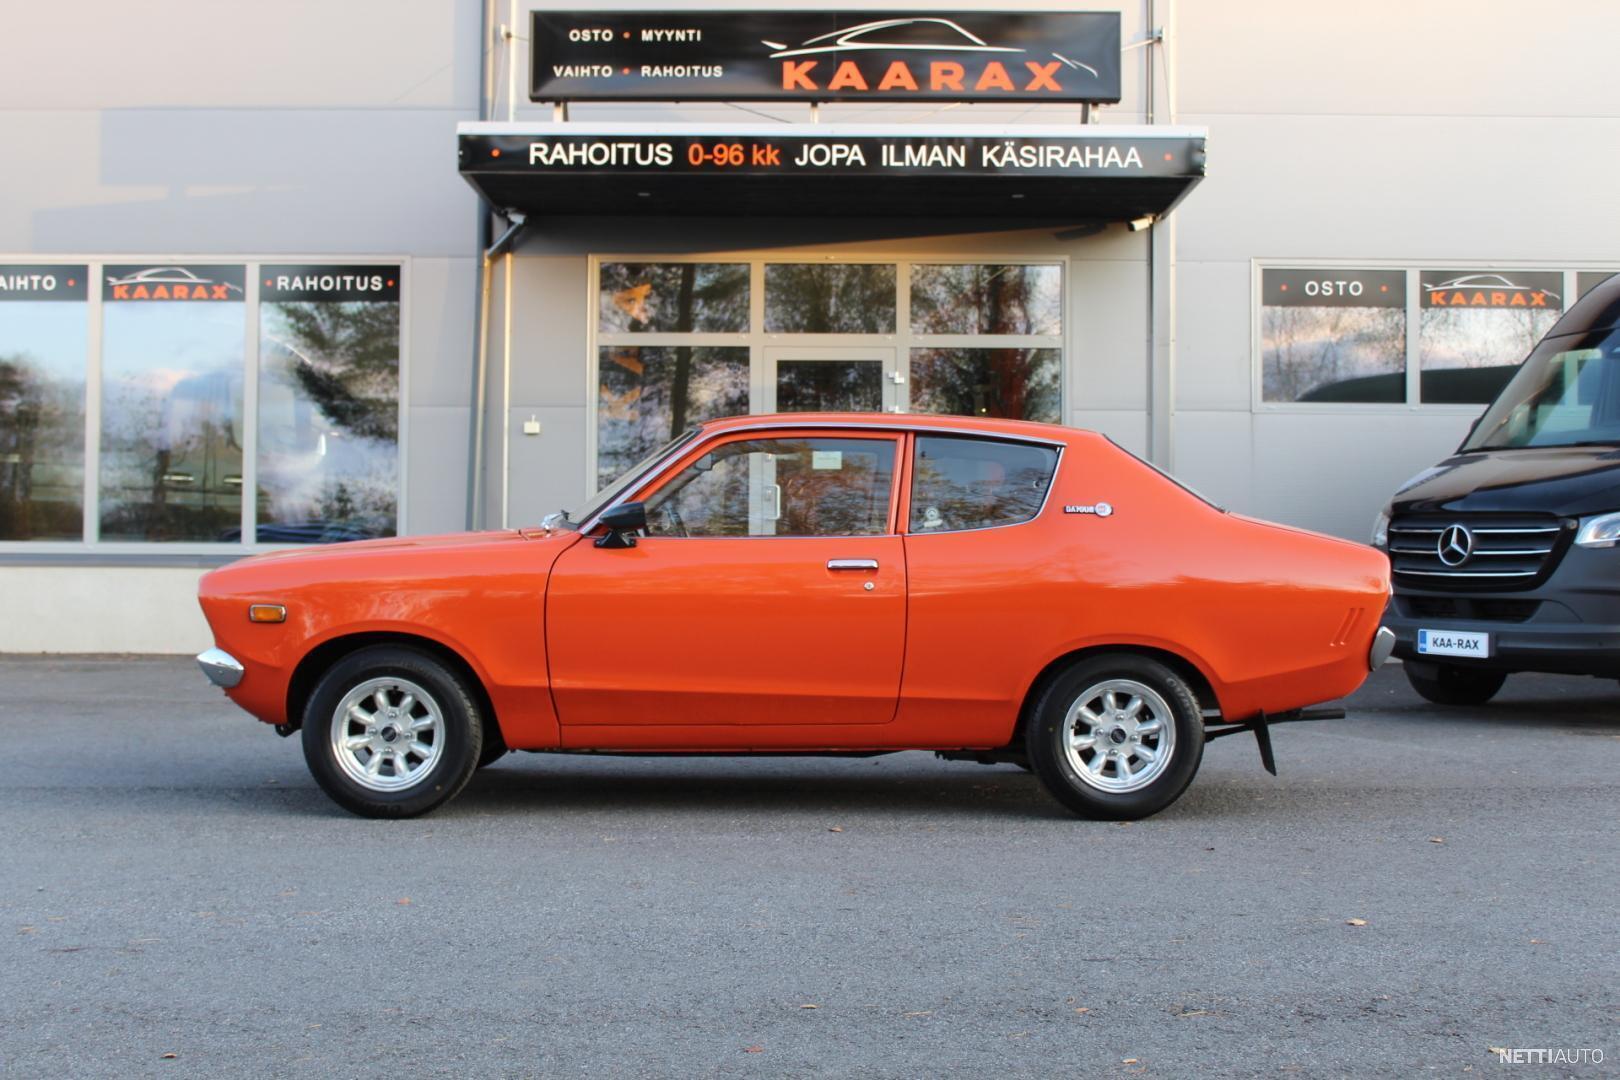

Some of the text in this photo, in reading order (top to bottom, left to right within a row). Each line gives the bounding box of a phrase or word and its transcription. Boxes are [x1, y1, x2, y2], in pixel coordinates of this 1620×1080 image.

[569, 29, 702, 42] OSTO MYYNTI
[552, 65, 724, 78] VAIHTO RAHOITUS
[782, 61, 1063, 91] KAARAX
[529, 141, 1143, 169] RAHOITUS 0-96 kk JOPA ILMAN KÄSIRAHAA
[276, 276, 383, 292] RAHOITUS
[1304, 281, 1364, 297] OSTO
[113, 285, 229, 300] KAARAX
[1430, 291, 1546, 306] KAARAX
[1432, 637, 1479, 650] KAA-RAX
